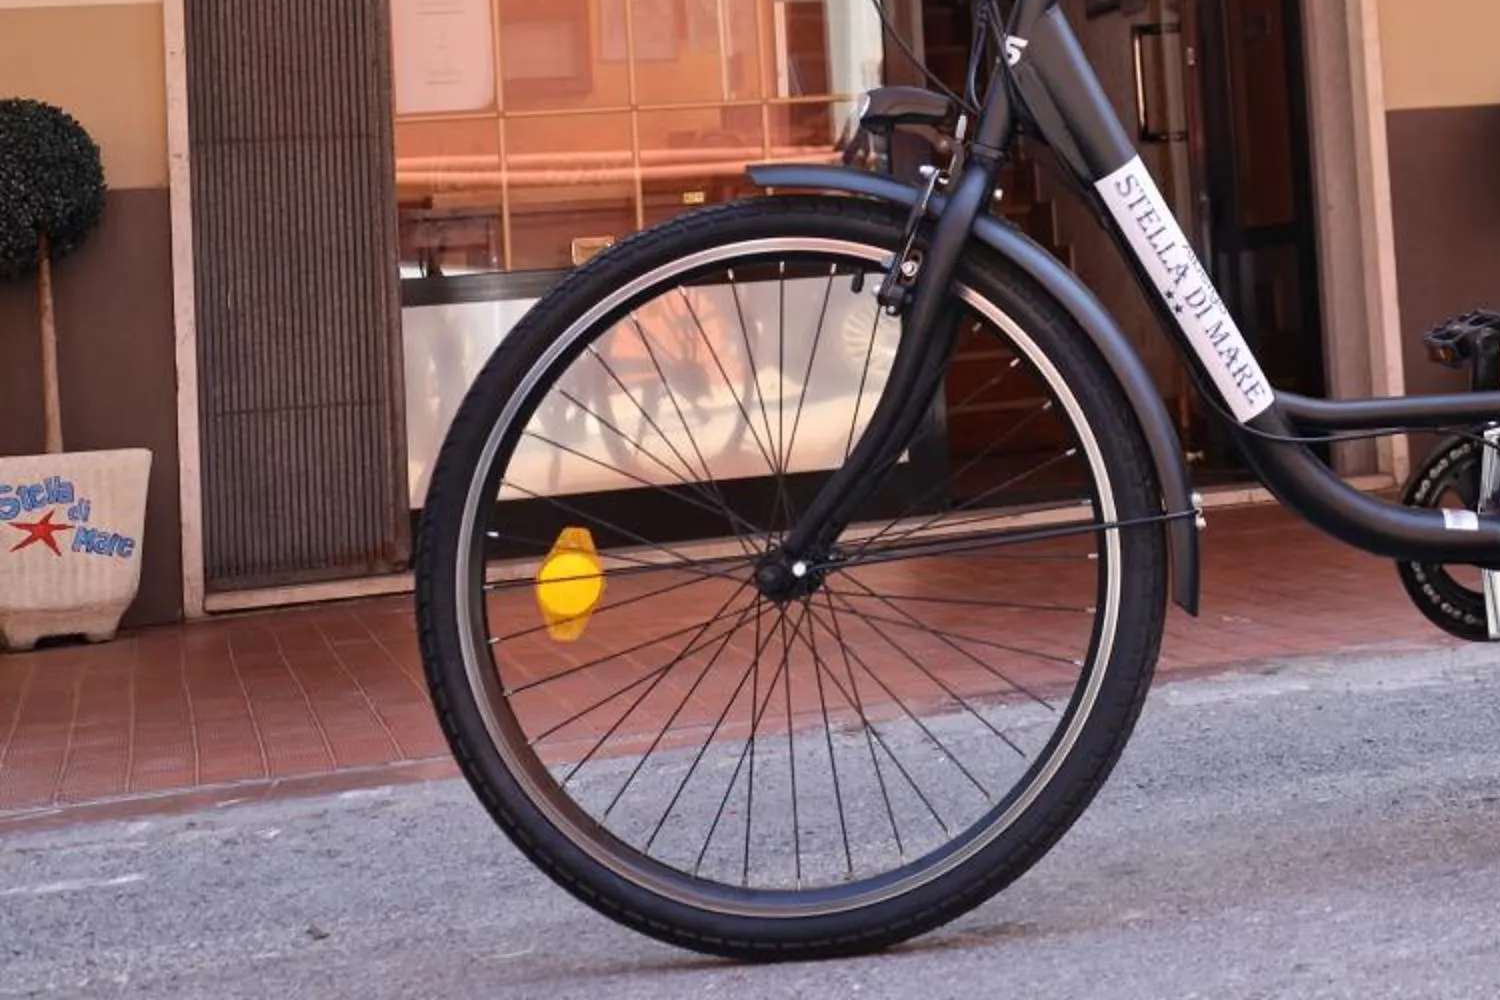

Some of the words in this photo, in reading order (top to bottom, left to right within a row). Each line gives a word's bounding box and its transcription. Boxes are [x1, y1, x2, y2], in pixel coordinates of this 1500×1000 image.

[1115, 173, 1188, 288] STELLA
[1184, 288, 1211, 319] DI
[1205, 321, 1266, 405] MARE
[72, 526, 135, 558] Mare
